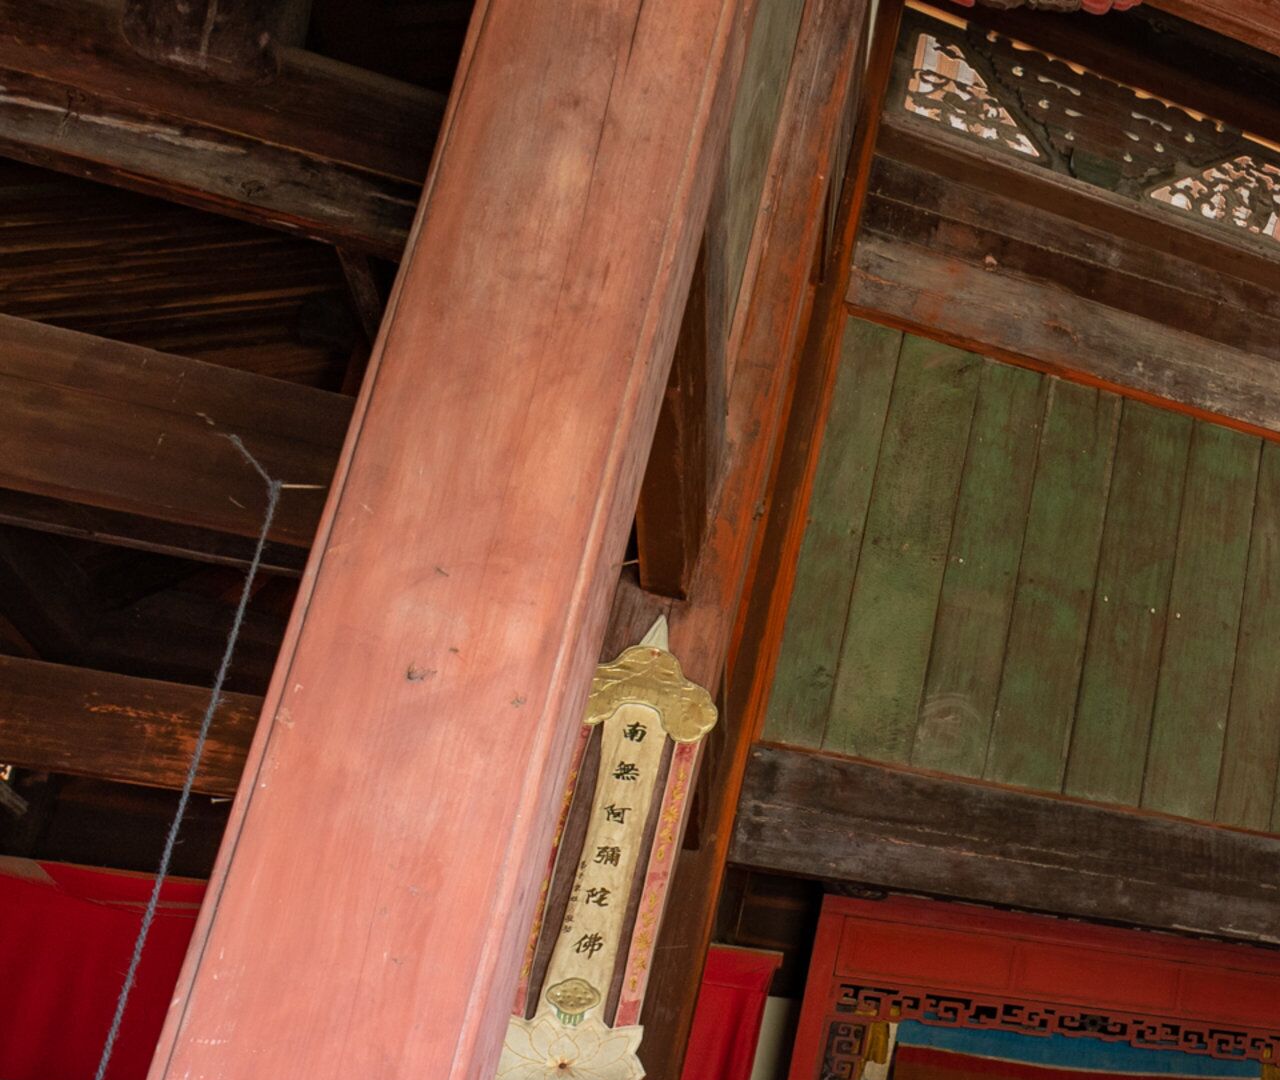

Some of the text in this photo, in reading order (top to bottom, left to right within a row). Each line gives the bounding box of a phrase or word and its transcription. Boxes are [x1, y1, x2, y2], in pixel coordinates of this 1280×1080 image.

[574, 722, 648, 960] 南無阿彌陀佛
